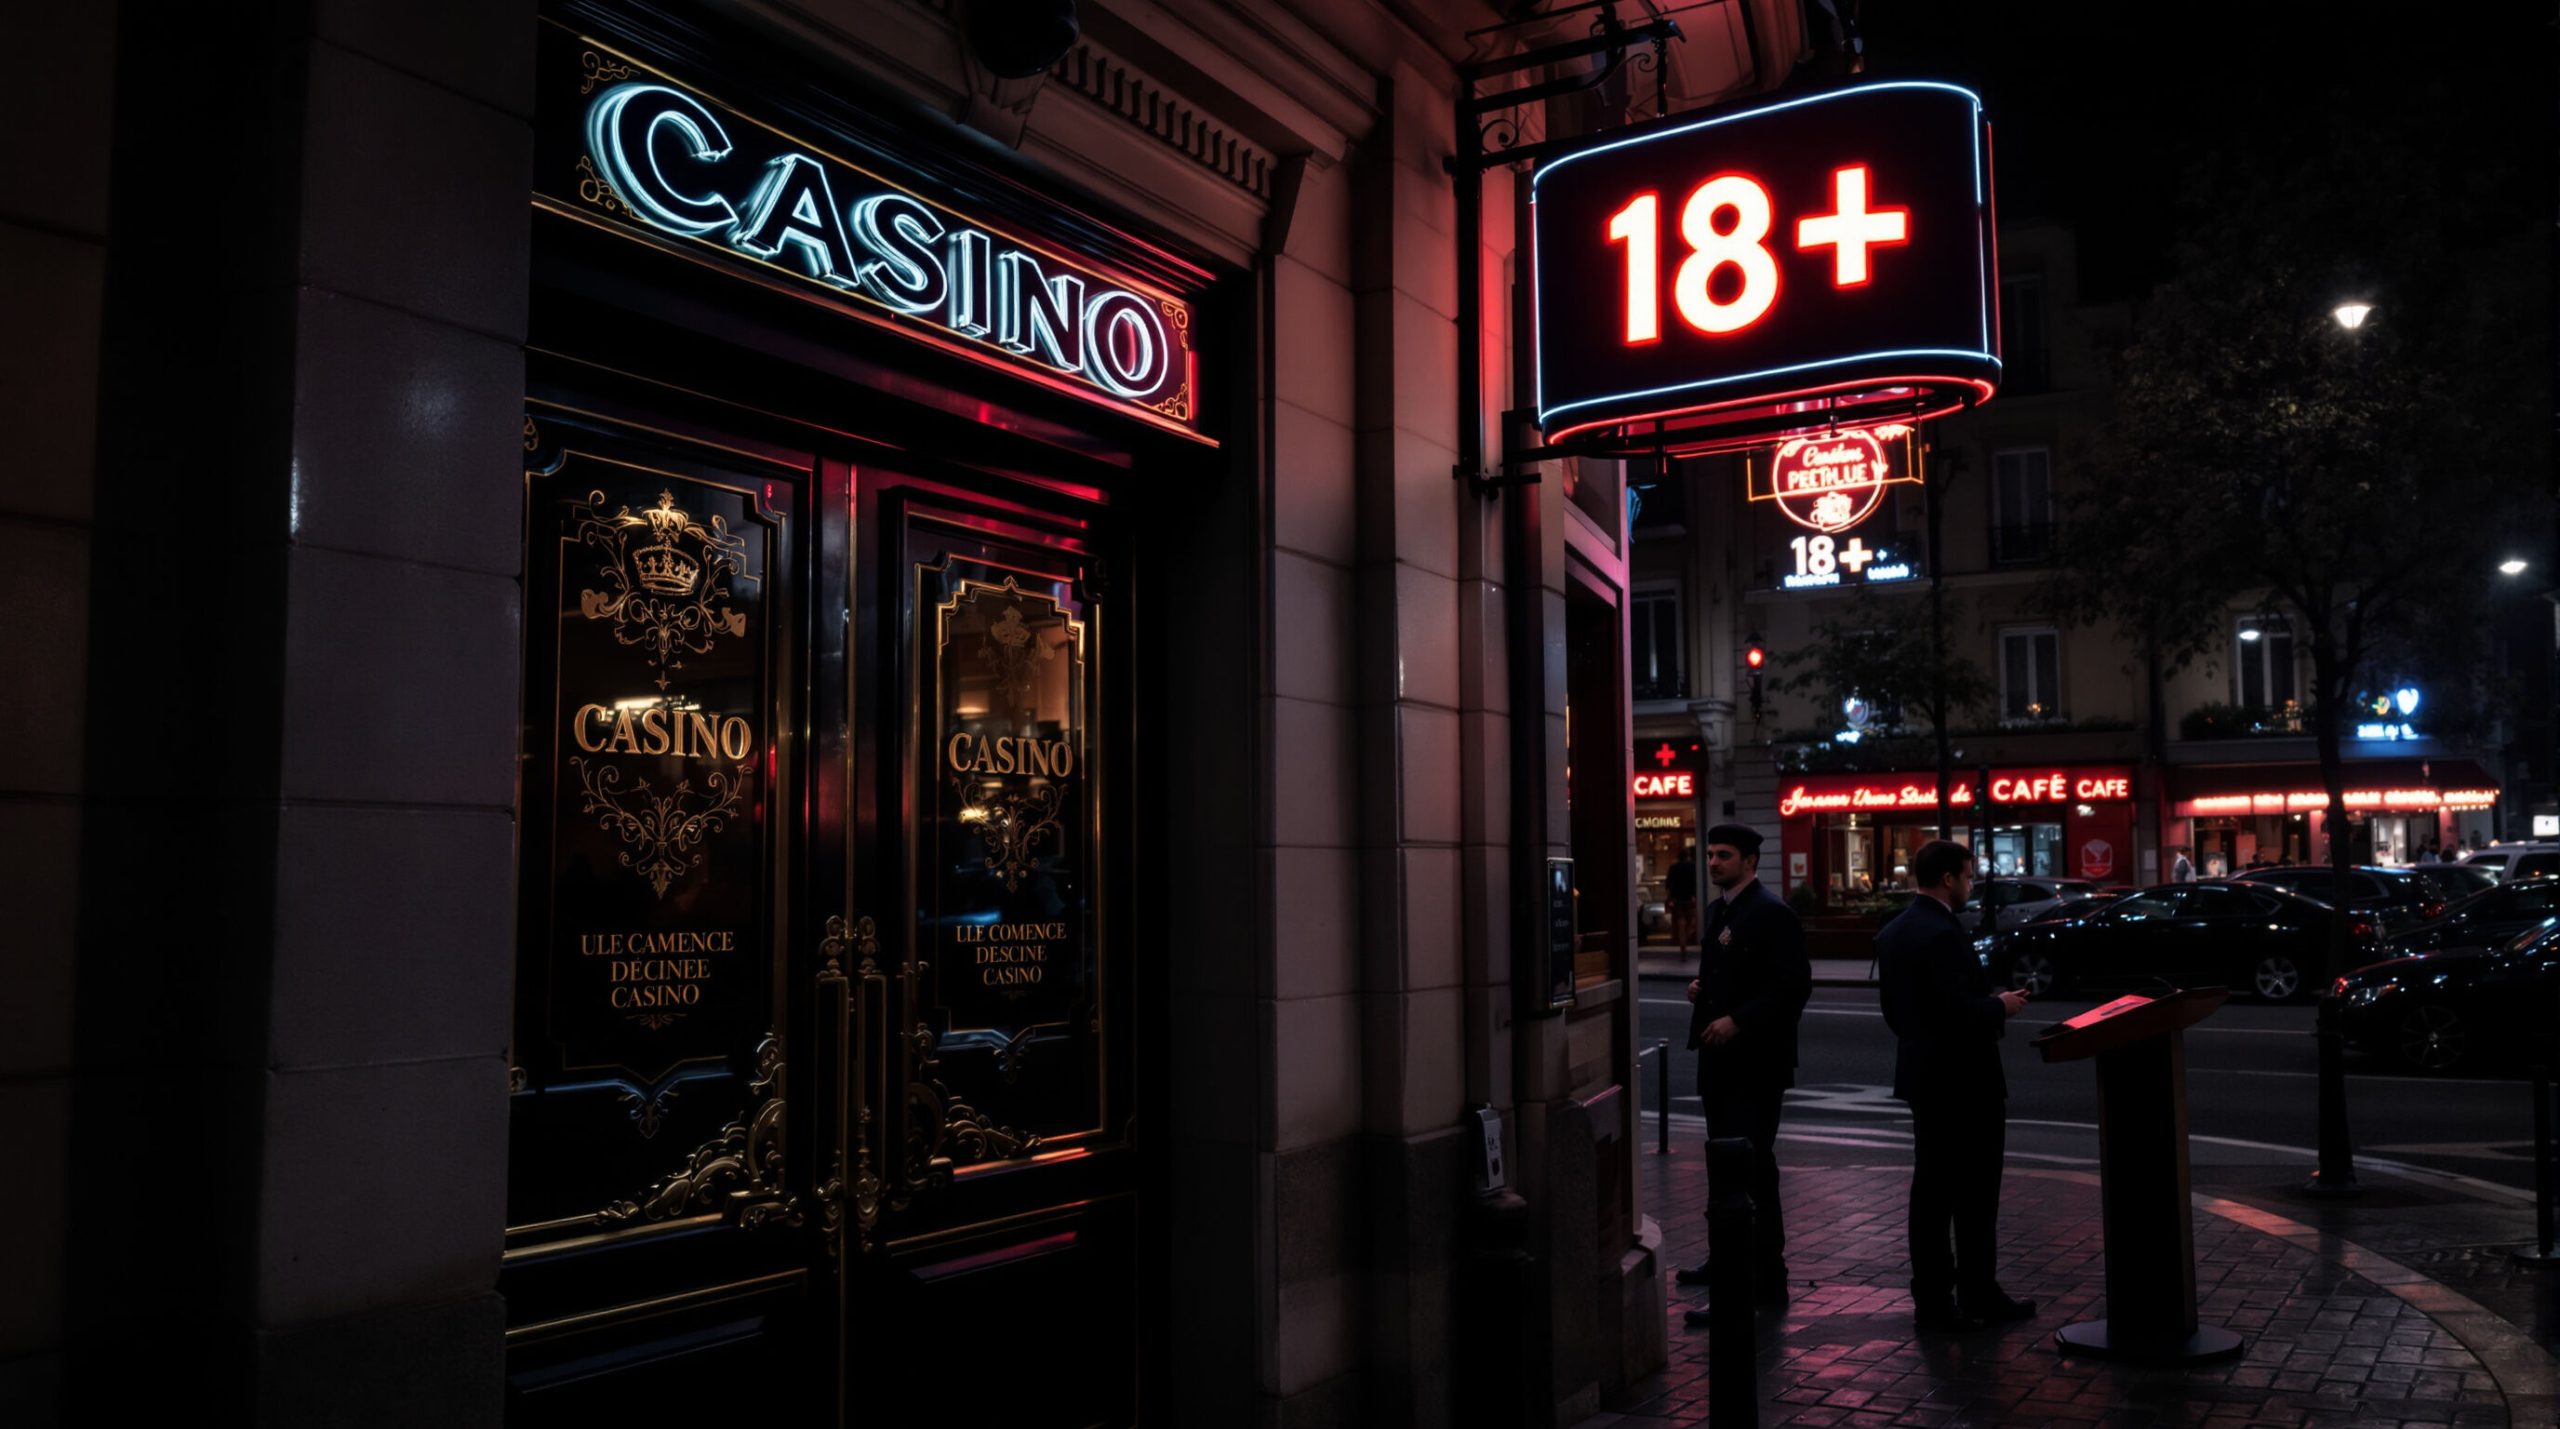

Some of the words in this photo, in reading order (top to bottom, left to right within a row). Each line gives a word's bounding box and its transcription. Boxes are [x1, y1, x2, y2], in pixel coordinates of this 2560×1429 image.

[584, 81, 1170, 398] CASINO
[1606, 163, 1908, 345] 18+
[1790, 535, 1873, 575] 18+
[574, 703, 752, 761] CASINO
[948, 731, 1074, 778] CASINO
[1633, 775, 1692, 795] CAFE
[1992, 774, 2068, 801] CAFÉ
[2076, 779, 2129, 798] CAFE
[579, 933, 624, 957] ULE
[627, 930, 736, 955] CAMENCE
[988, 922, 1068, 942] COMENCE
[976, 945, 1047, 963] DESCINE
[983, 965, 1042, 986] CASINO
[611, 984, 701, 1010] CASINO
